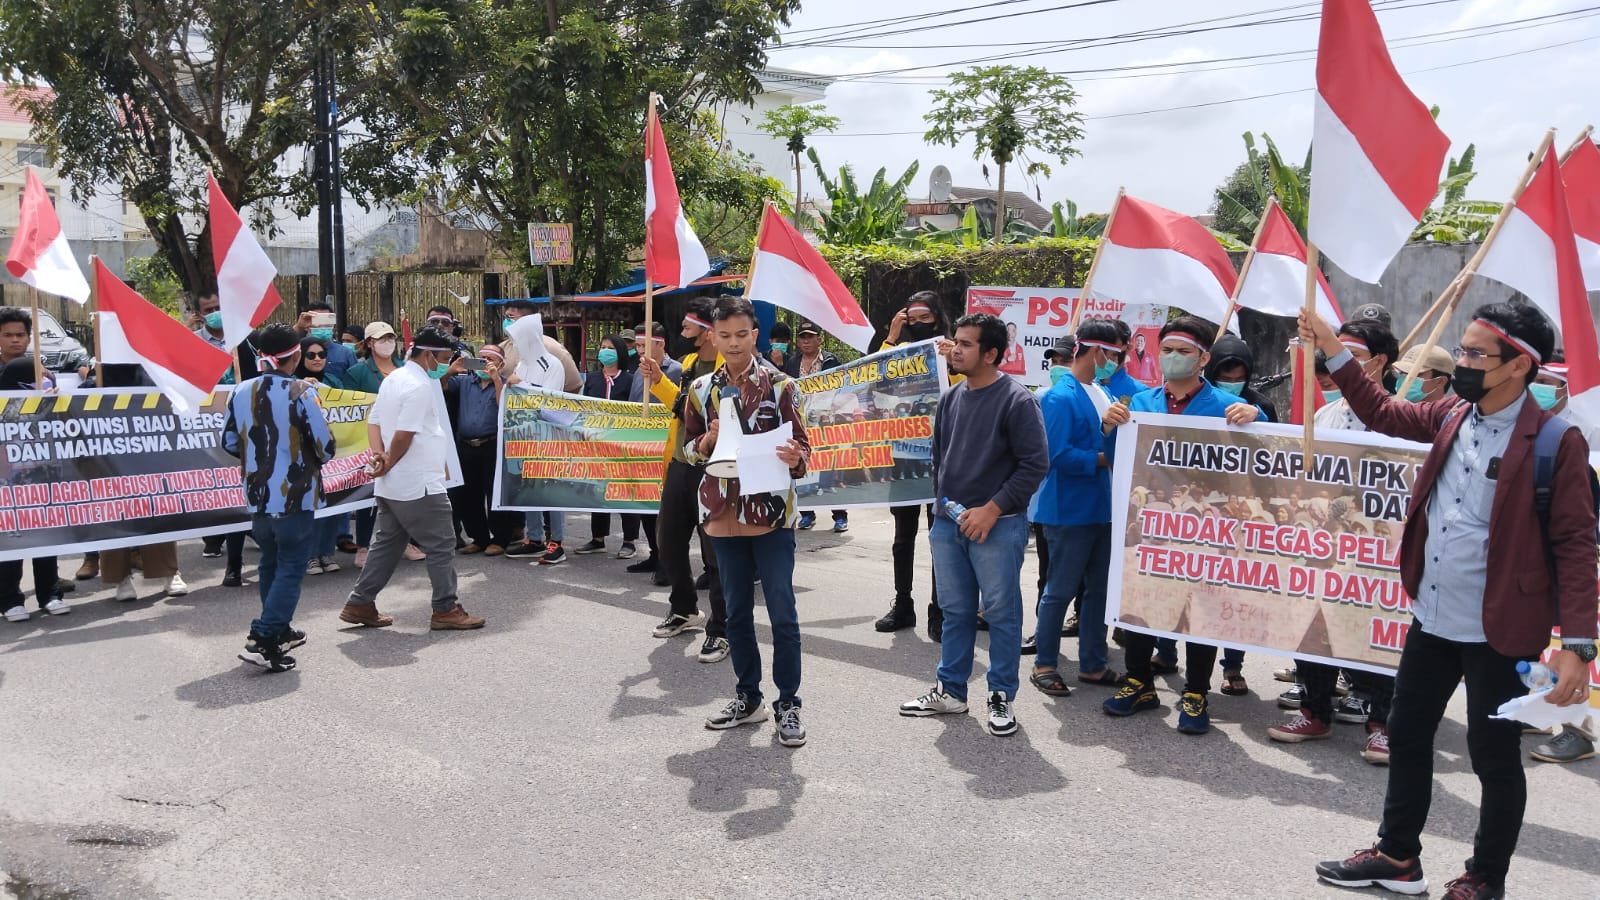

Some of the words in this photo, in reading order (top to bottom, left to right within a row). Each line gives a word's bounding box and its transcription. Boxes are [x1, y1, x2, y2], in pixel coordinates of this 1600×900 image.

[1027, 296, 1080, 327] PSI
[1085, 298, 1126, 312] Hadir
[1024, 336, 1059, 347] HADI
[797, 370, 846, 395] RAKAT
[885, 354, 929, 379] SIAK
[321, 405, 370, 424] RAKAT
[506, 394, 544, 409] ALIANSI
[38, 417, 129, 439] PROVINSI
[132, 414, 176, 433] RIAU
[180, 412, 224, 431] BERS
[583, 415, 612, 429] DAN
[806, 427, 825, 449] GIL
[823, 424, 853, 447] DAN
[851, 415, 932, 444] MEMPROSES
[6, 442, 50, 463] DAN
[54, 435, 173, 460] MAHASISWA
[176, 431, 216, 450] ANTI
[807, 449, 834, 472] AKAT
[862, 445, 895, 468] SIAK
[522, 461, 556, 479] PEMILIK
[1149, 440, 1248, 473] ALIANSI
[1254, 449, 1351, 486] SAPMA
[1359, 460, 1408, 491] IPK
[13, 483, 50, 507] RIAU
[51, 480, 90, 504] AGAR
[90, 473, 165, 501] MENGUSUT
[164, 468, 214, 492] TUNTAS
[213, 466, 243, 487] PROS
[16, 505, 68, 530] MALAH
[67, 497, 152, 526] DITETAPKAN
[152, 494, 183, 516] JADI
[181, 487, 247, 512] TERSANGK
[1140, 509, 1236, 547] TINDAK
[1243, 521, 1331, 560] TEGAS
[1338, 534, 1401, 570] PELA
[1136, 544, 1282, 594] TERUTAMA
[1287, 564, 1317, 599] DI
[1321, 572, 1415, 614] DAYUN
